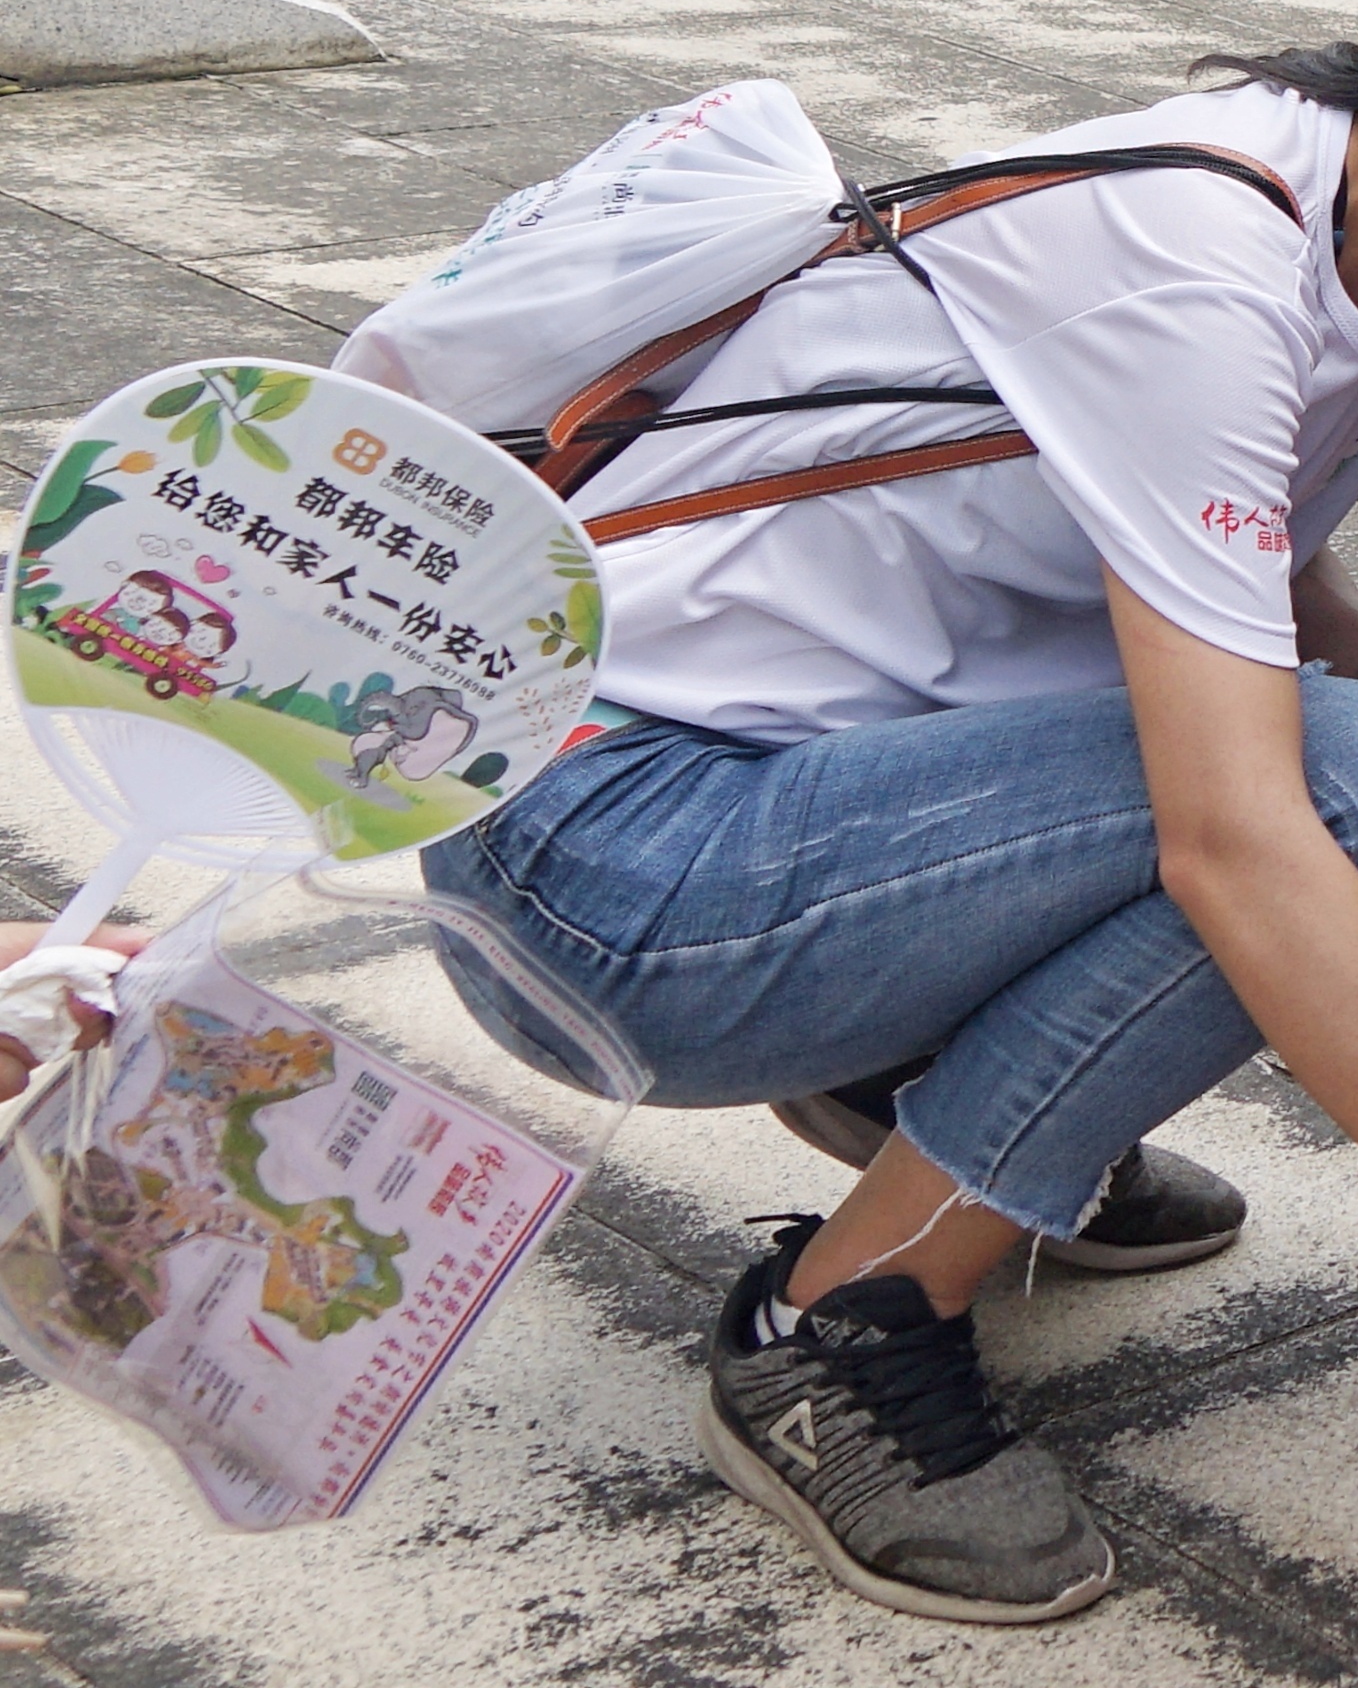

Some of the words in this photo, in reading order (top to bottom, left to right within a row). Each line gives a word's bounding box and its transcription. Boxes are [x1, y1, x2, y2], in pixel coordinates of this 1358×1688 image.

[293, 475, 462, 588] 都邦车险
[378, 478, 420, 505] DUBON
[388, 455, 498, 528] 都邦保险
[150, 466, 519, 683] 给您和家人一份安心
